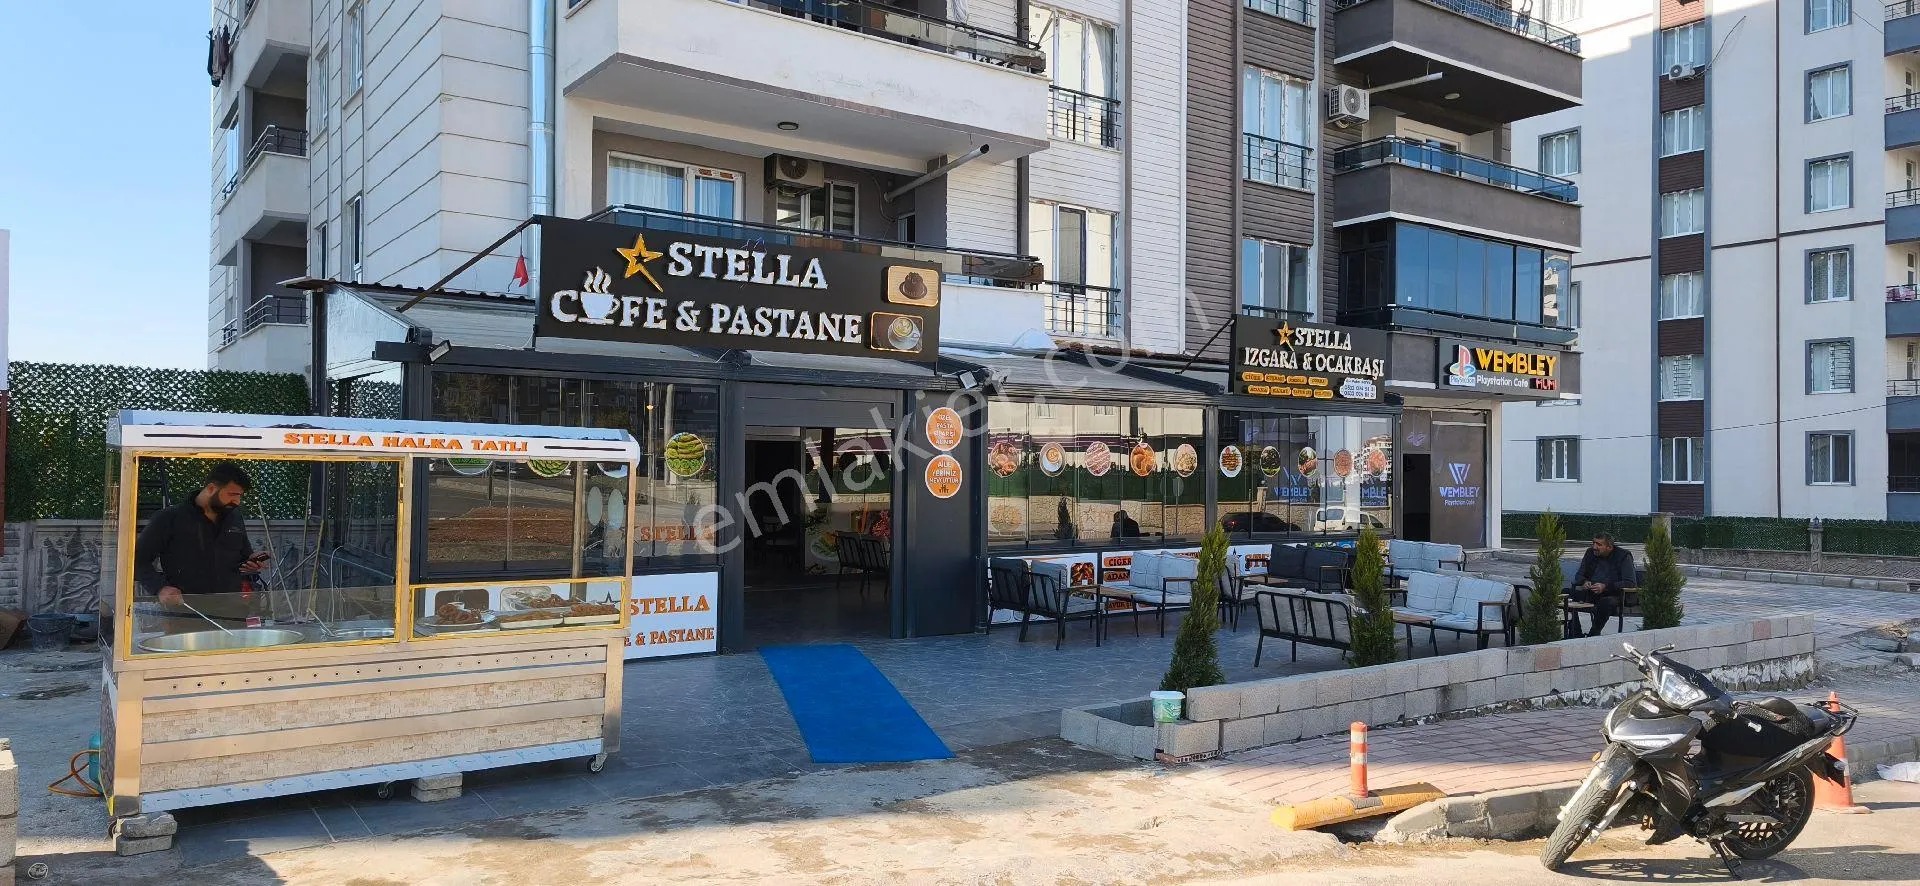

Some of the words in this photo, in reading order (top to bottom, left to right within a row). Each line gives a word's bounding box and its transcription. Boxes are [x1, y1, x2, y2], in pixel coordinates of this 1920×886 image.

[667, 240, 829, 290] STELLA
[551, 288, 668, 331] CFE
[675, 300, 701, 333] &
[709, 302, 862, 345] PASTANE
[1295, 327, 1352, 351] STELLA
[1243, 346, 1298, 370] IZGARA
[1302, 352, 1313, 371] &
[1315, 353, 1385, 380] OCAKBAŞI
[1475, 347, 1557, 377] WEMBLEY
[1476, 375, 1513, 388] Playstation
[1513, 378, 1529, 388] Cafe
[283, 432, 374, 447] STELLA
[382, 436, 463, 450] HALKA
[471, 439, 528, 452] TATLI
[1439, 486, 1480, 498] WEMBLEY
[1106, 572, 1129, 581] ADAN
[630, 594, 711, 616] STELLA
[635, 632, 646, 646] &
[649, 627, 715, 645] PASTANE
